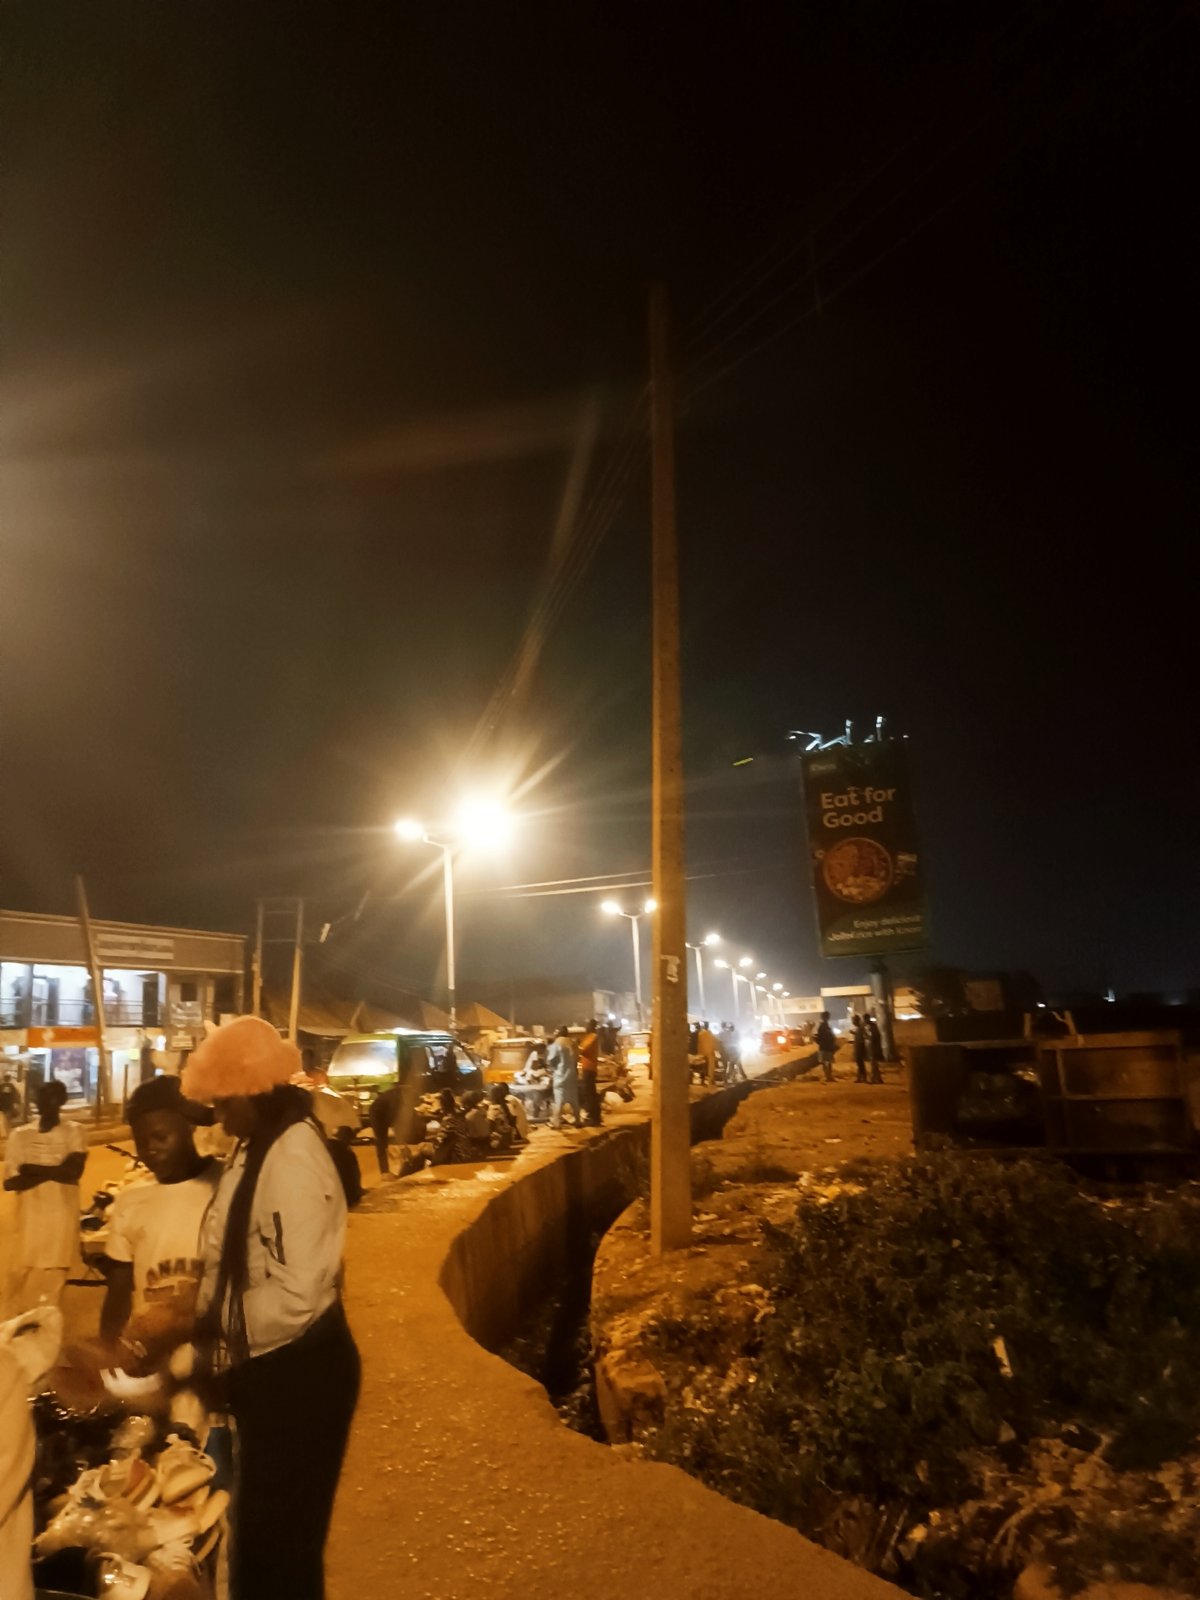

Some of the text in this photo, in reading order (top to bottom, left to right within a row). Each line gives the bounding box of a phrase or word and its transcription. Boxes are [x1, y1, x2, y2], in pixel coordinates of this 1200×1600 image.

[821, 787, 896, 809] Eat for
[823, 806, 883, 828] Good
